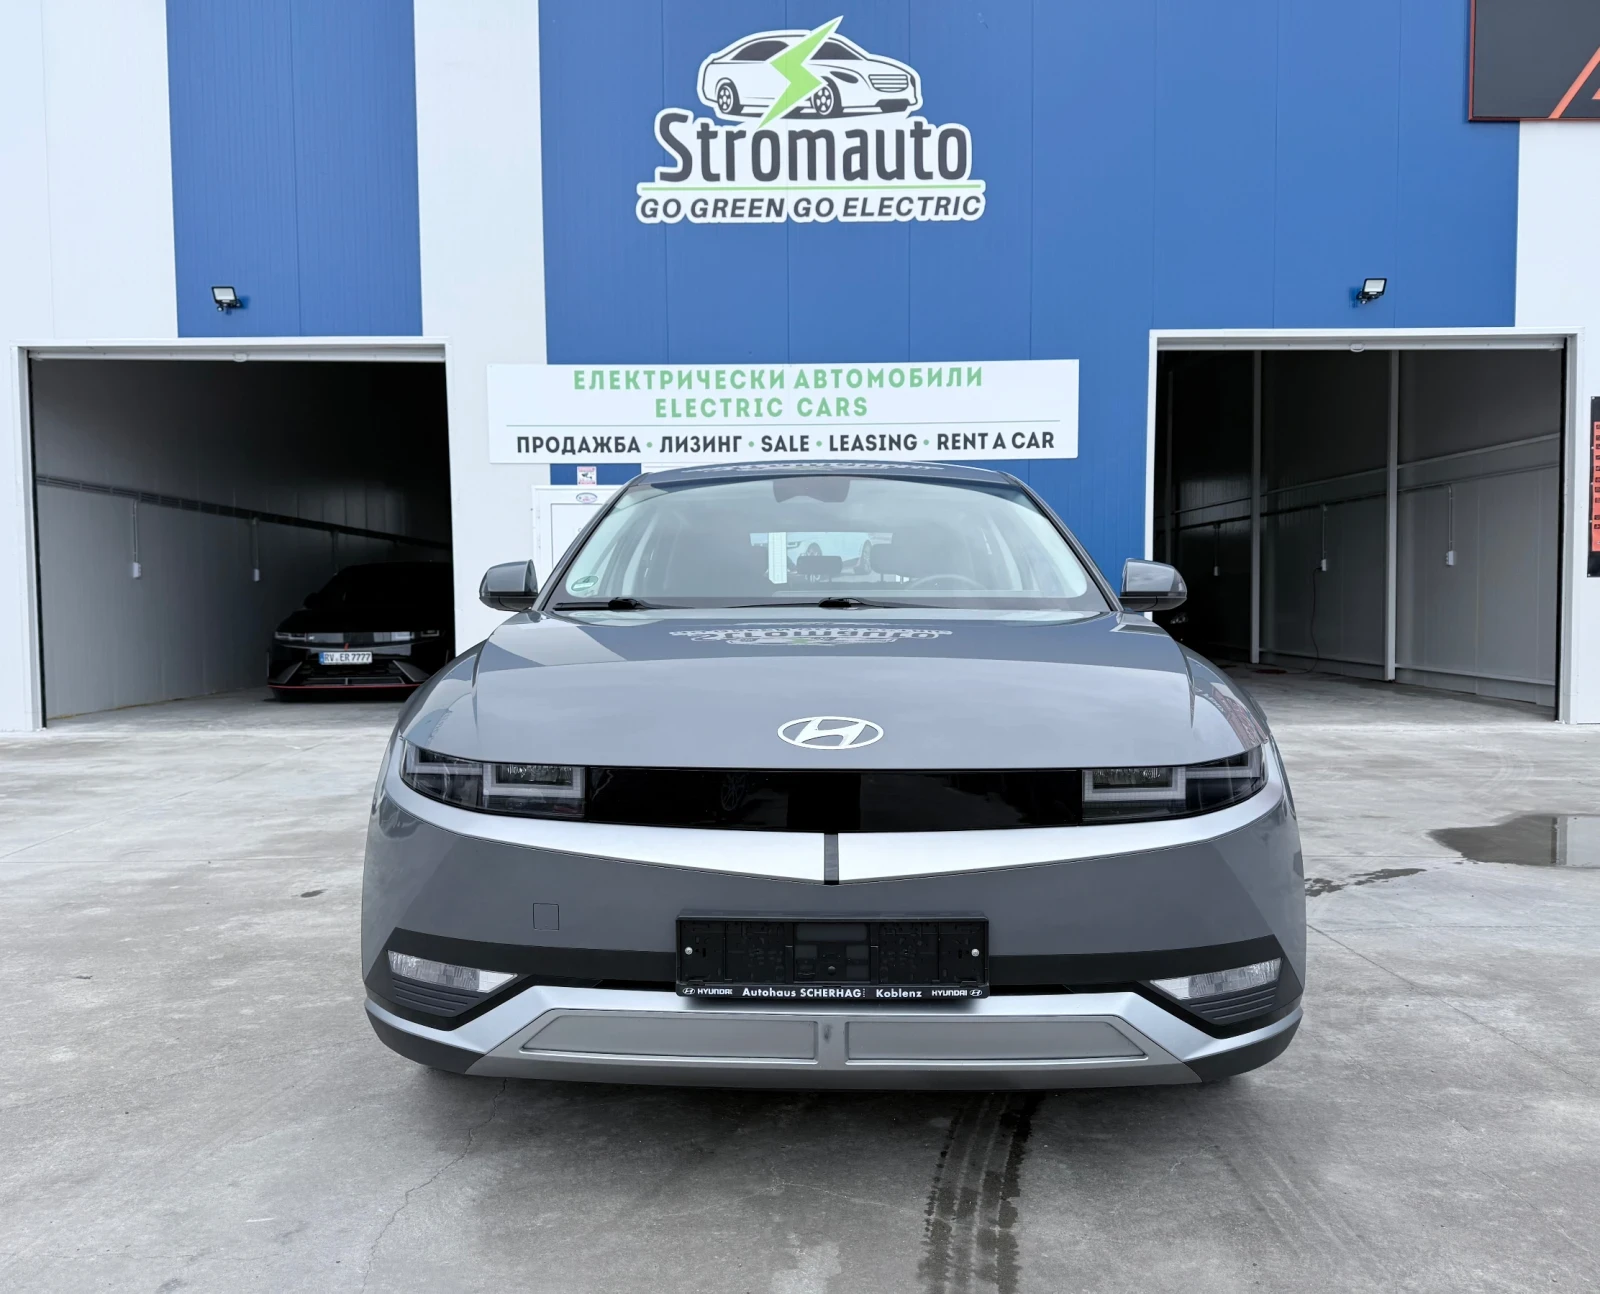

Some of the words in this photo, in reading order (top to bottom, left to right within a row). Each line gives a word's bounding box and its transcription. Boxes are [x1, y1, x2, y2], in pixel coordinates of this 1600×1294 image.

[658, 111, 968, 183] Stromauto
[640, 198, 682, 219] GO
[690, 198, 785, 218] GREEN
[793, 197, 834, 218] GO
[842, 195, 981, 217] ELECTRIC
[573, 369, 785, 391] ЕЛЕКТРИЧЕСКИ
[794, 367, 983, 390] АВТОМОБИЛИ
[655, 396, 783, 419] ELECTRIC
[796, 396, 868, 417] CARS
[517, 436, 641, 456] ПРОДАЖБА
[659, 435, 742, 453] ЛИЗИНГ
[761, 434, 810, 453] SALE
[829, 433, 918, 452] LEASING
[937, 432, 989, 451] RENT
[992, 432, 1007, 450] A
[1011, 431, 1055, 449] CAR
[697, 987, 734, 996] HYUNDAI
[742, 987, 797, 997] Autohaus
[800, 987, 862, 998] SCHERHAG
[875, 988, 922, 998] Koblenz
[931, 989, 968, 998] HYUNDAI
